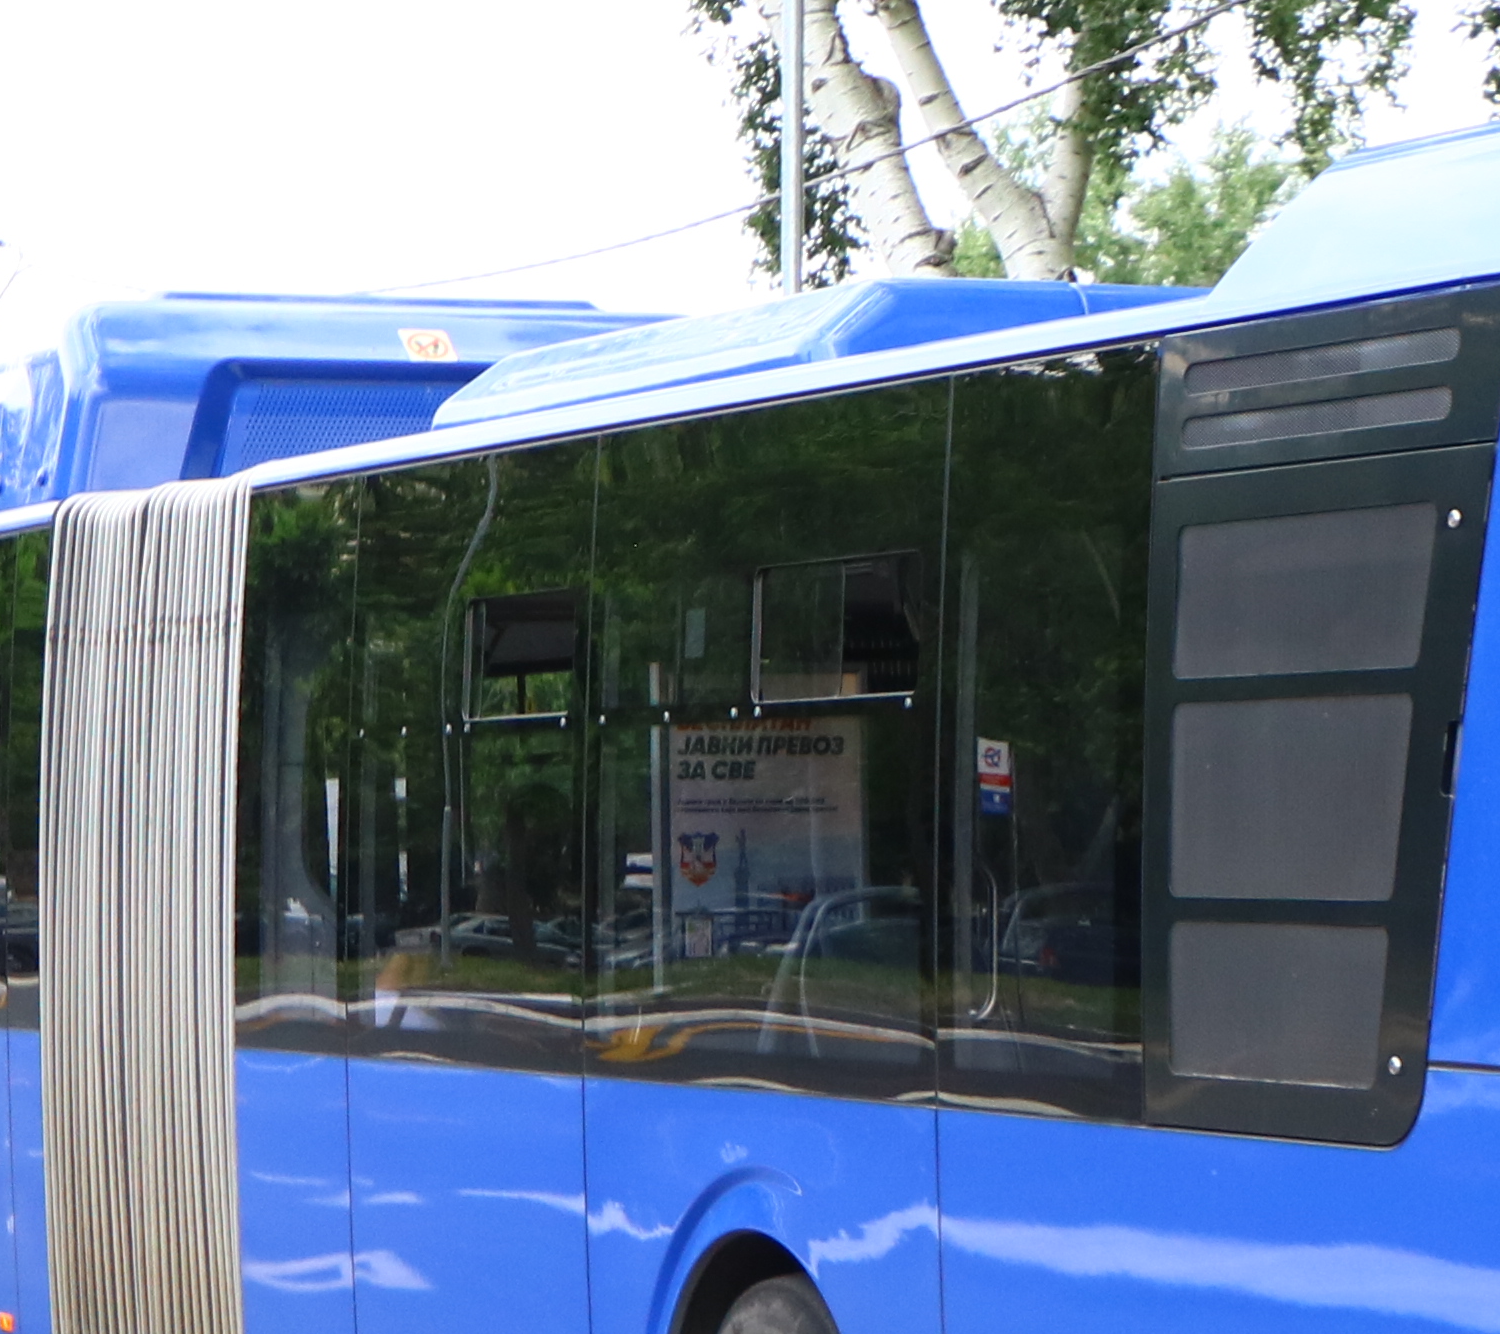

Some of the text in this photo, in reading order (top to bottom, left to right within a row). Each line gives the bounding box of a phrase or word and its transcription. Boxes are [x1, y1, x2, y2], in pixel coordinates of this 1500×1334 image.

[756, 734, 844, 756] ПРЕВОЗ
[677, 759, 757, 780] ЗА СВЕ
